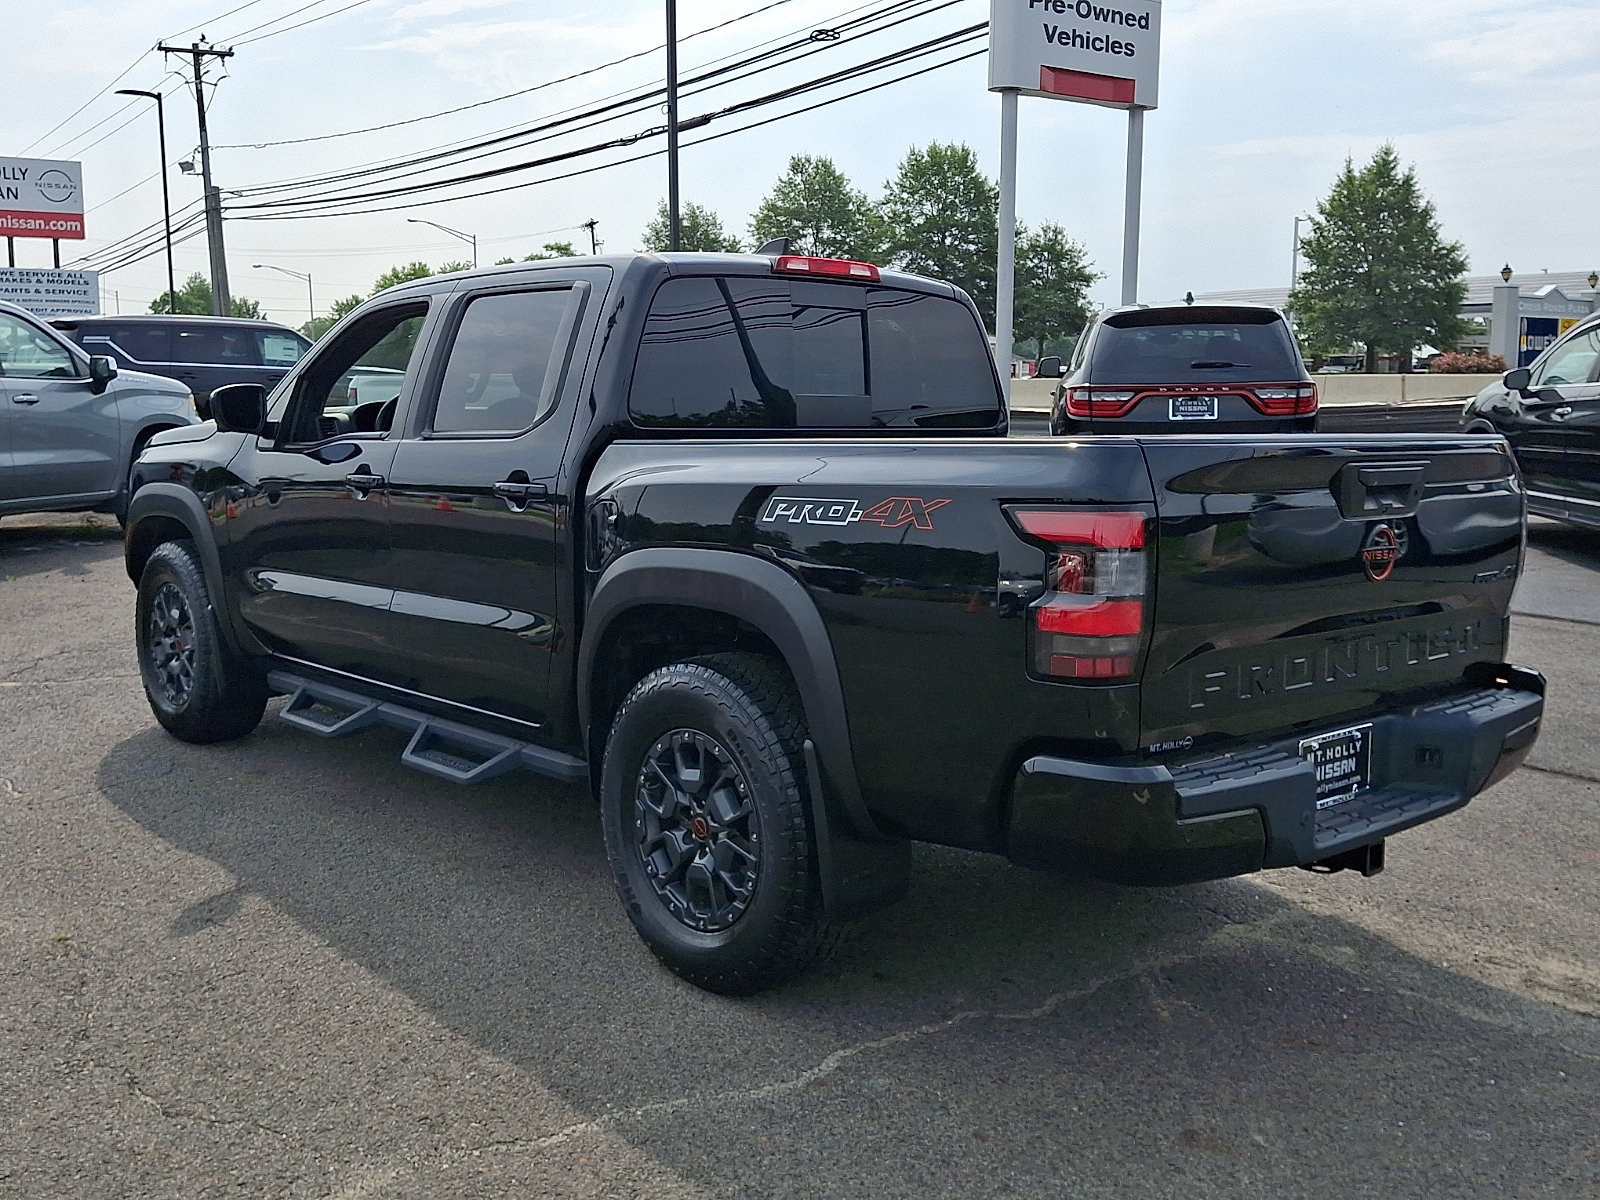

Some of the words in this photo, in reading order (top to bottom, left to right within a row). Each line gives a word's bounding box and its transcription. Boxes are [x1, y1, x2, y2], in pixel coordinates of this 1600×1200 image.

[1042, 23, 1136, 57] Vehicles
[0, 166, 28, 181] LLY
[35, 182, 77, 190] NISSAN
[44, 288, 89, 296] SERVICE
[1363, 549, 1397, 562] NISSA
[1189, 620, 1480, 708] FRONTIER
[1326, 741, 1361, 760] HOLLY
